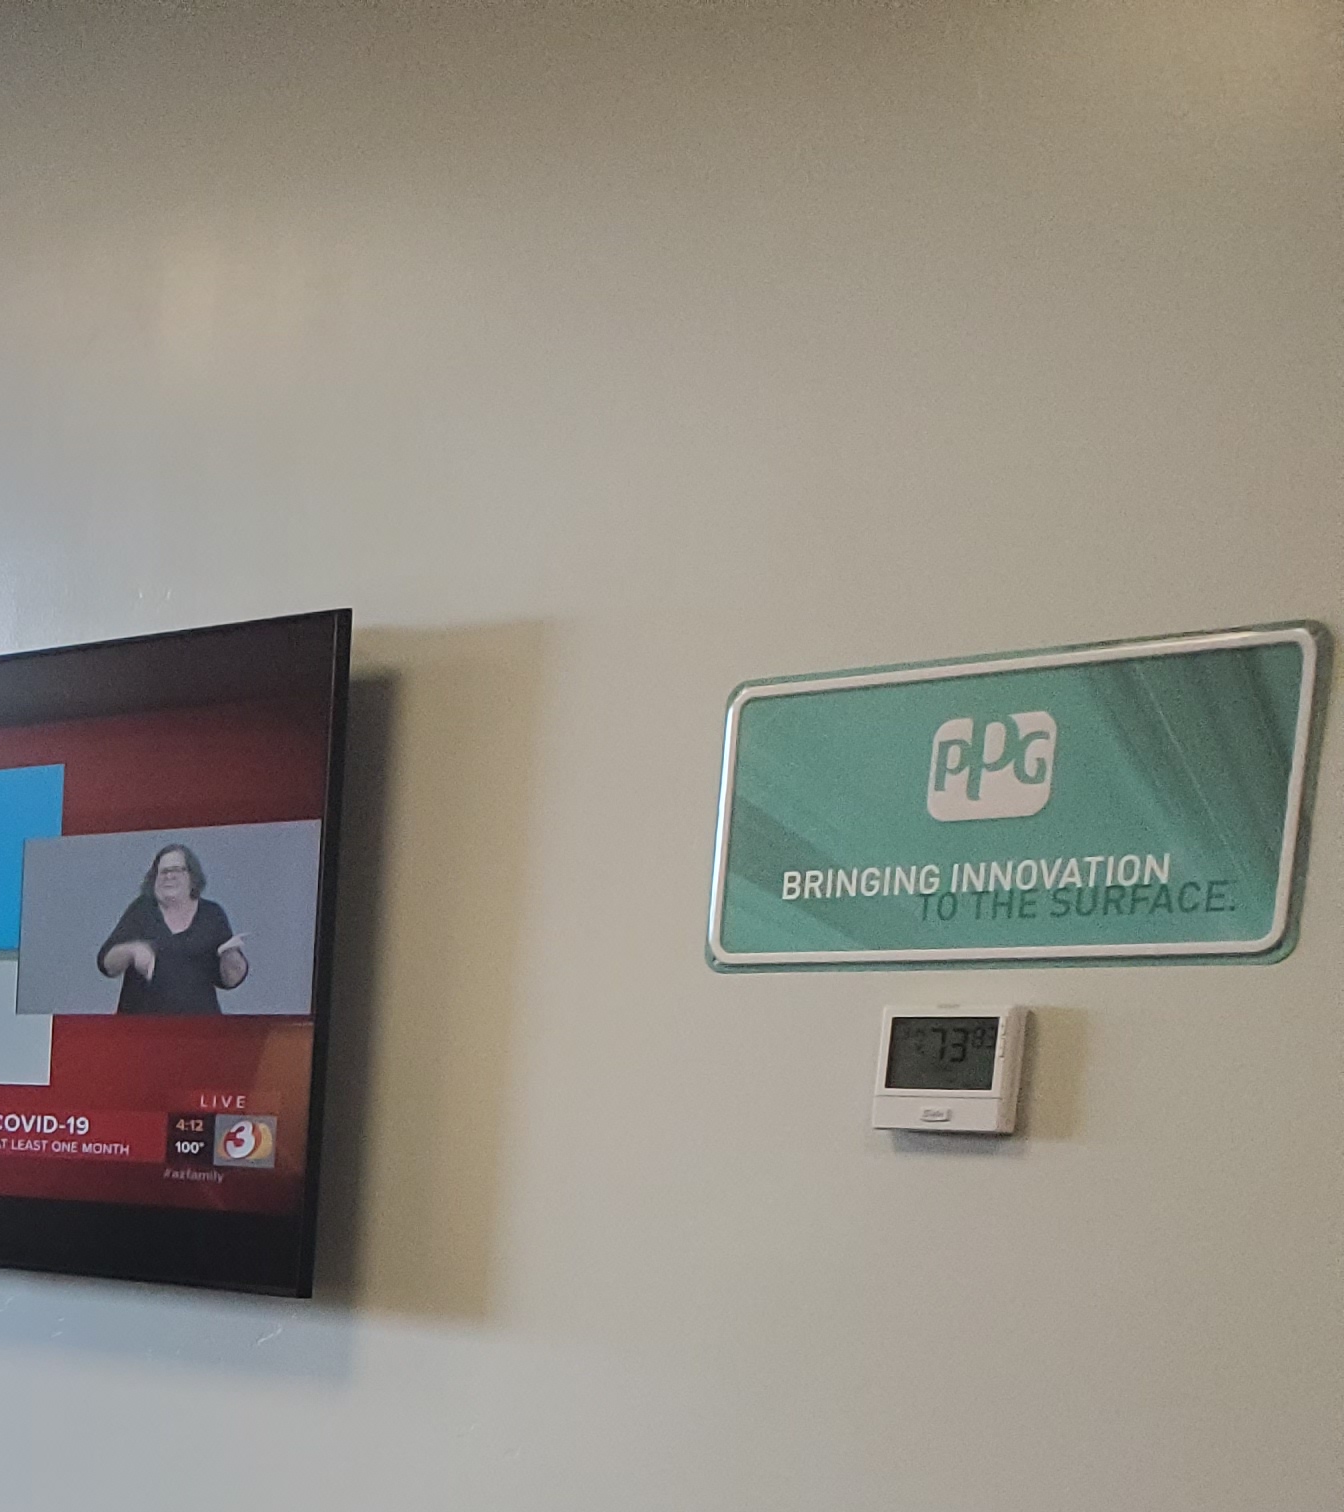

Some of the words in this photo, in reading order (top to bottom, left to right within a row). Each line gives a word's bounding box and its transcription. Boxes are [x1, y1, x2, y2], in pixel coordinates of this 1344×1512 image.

[932, 713, 1053, 804] PPG
[782, 863, 941, 900] BRINGING
[950, 852, 1171, 894] INNOVATION
[918, 889, 958, 922] TO
[968, 886, 1038, 920] THE
[200, 1095, 247, 1109] LIVE
[175, 1119, 204, 1132] 4:12
[225, 1120, 256, 1159] 3
[11, 1138, 49, 1152] LEAST
[51, 1140, 78, 1153] ONE
[81, 1142, 130, 1156] MONTH
